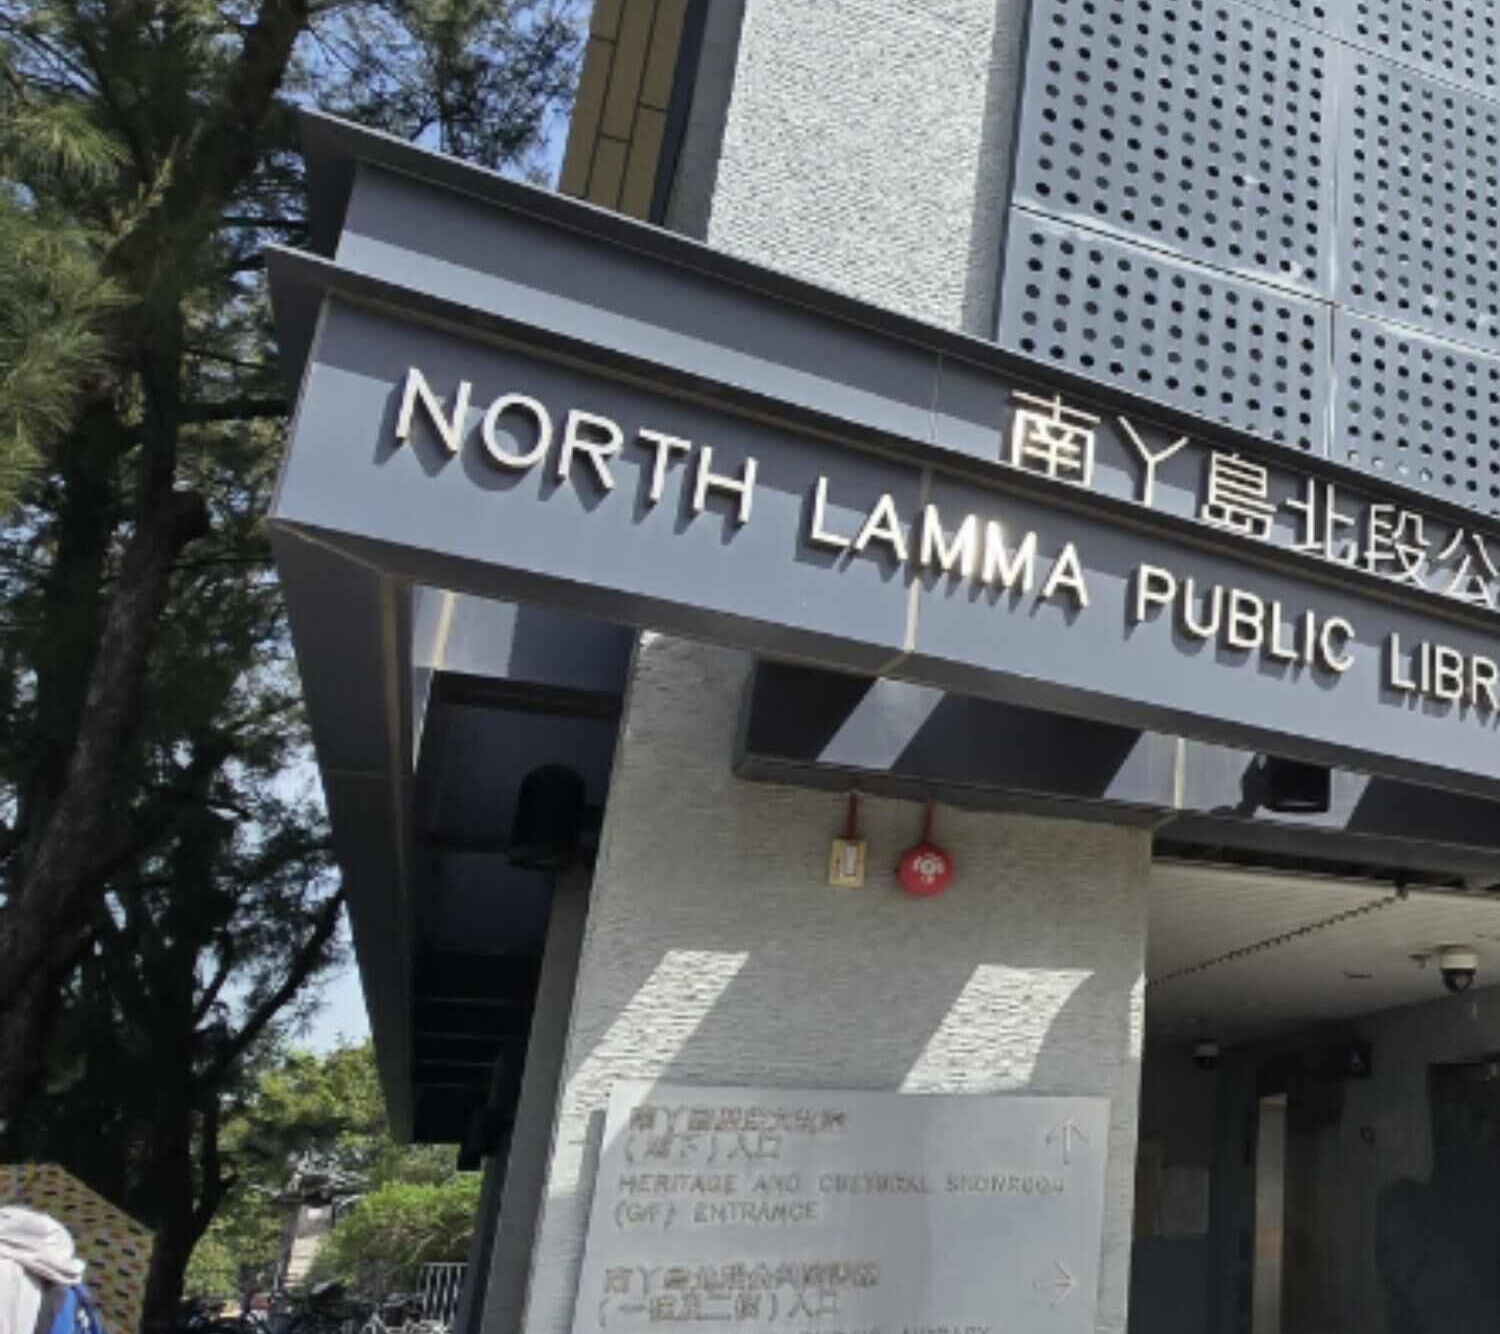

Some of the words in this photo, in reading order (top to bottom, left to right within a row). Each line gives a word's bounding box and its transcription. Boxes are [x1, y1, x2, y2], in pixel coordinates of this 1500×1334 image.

[394, 366, 759, 525] NORTH
[809, 474, 1090, 609] LAMMA
[1134, 563, 1356, 673] PUBLIC
[618, 1172, 738, 1196] HERITAGE
[751, 1172, 802, 1195] AND
[693, 1200, 820, 1224] ENTRANCE
